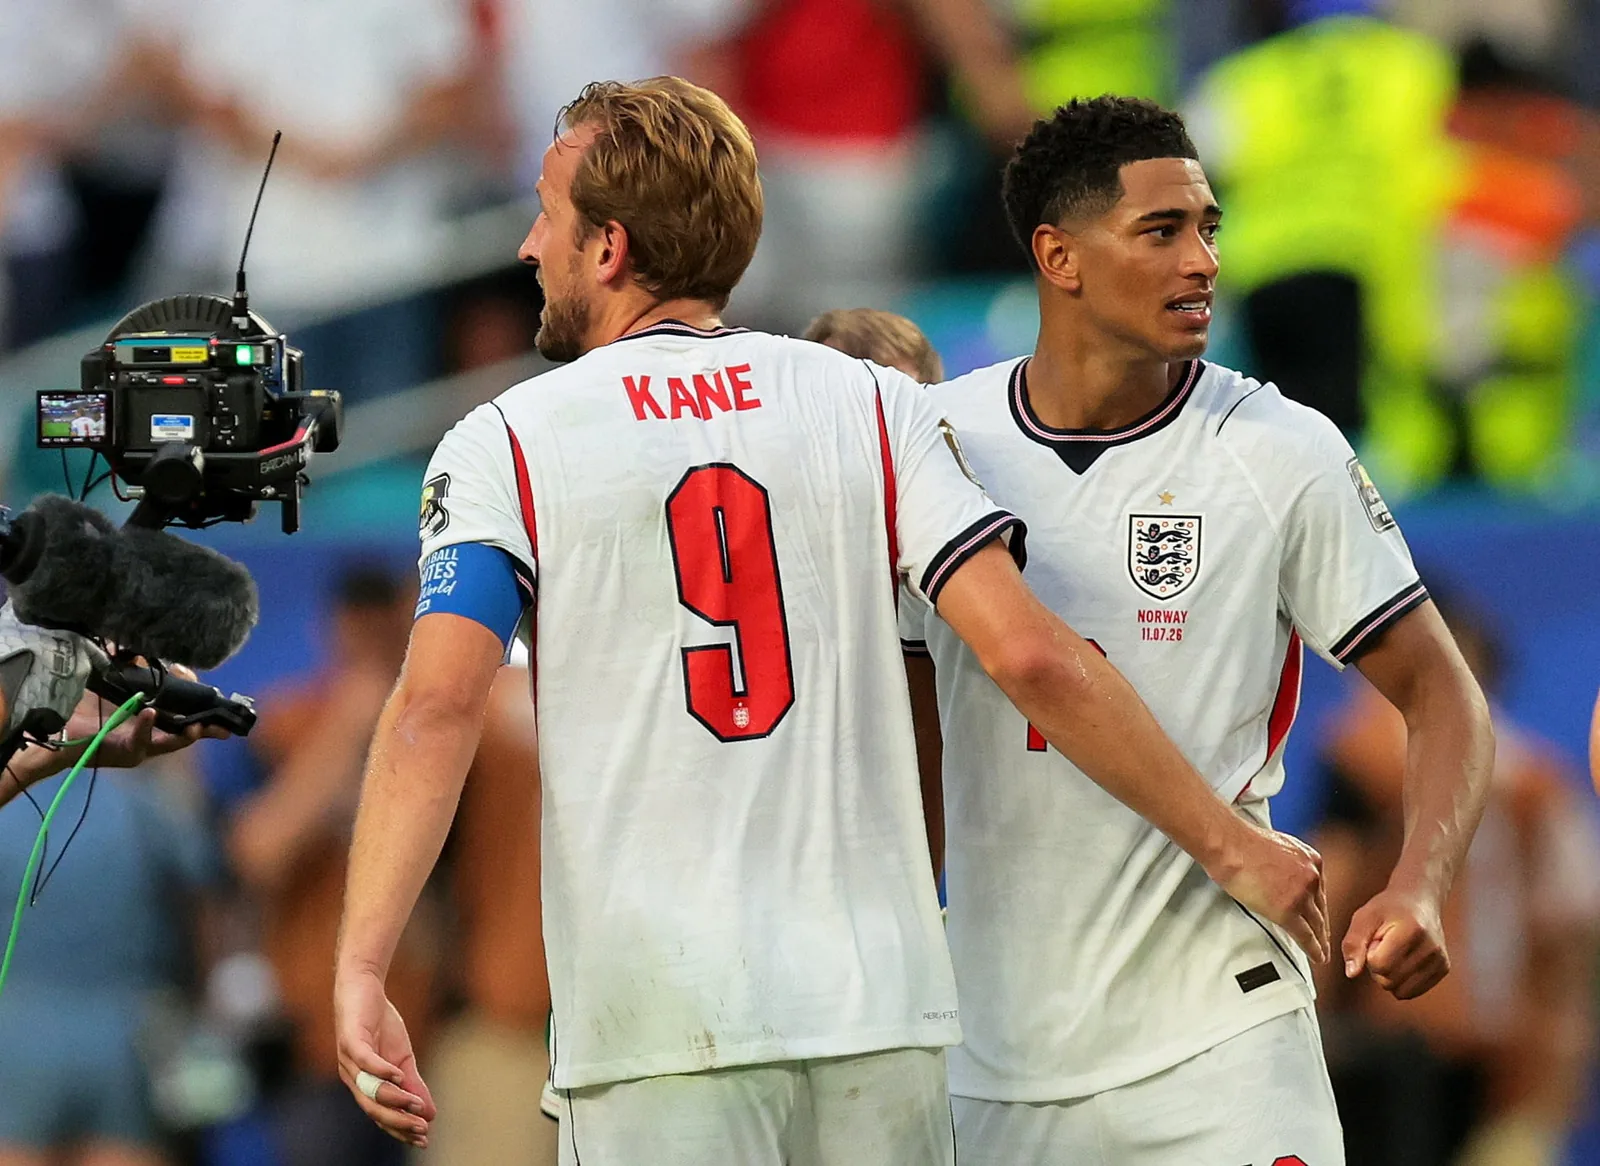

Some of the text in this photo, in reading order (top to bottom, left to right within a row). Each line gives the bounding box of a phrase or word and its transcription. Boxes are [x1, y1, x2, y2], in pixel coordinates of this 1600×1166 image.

[622, 363, 761, 421] KANE
[665, 462, 795, 743] 9
[1137, 609, 1188, 623] NORWAY
[1141, 627, 1183, 641] 11.07.26
